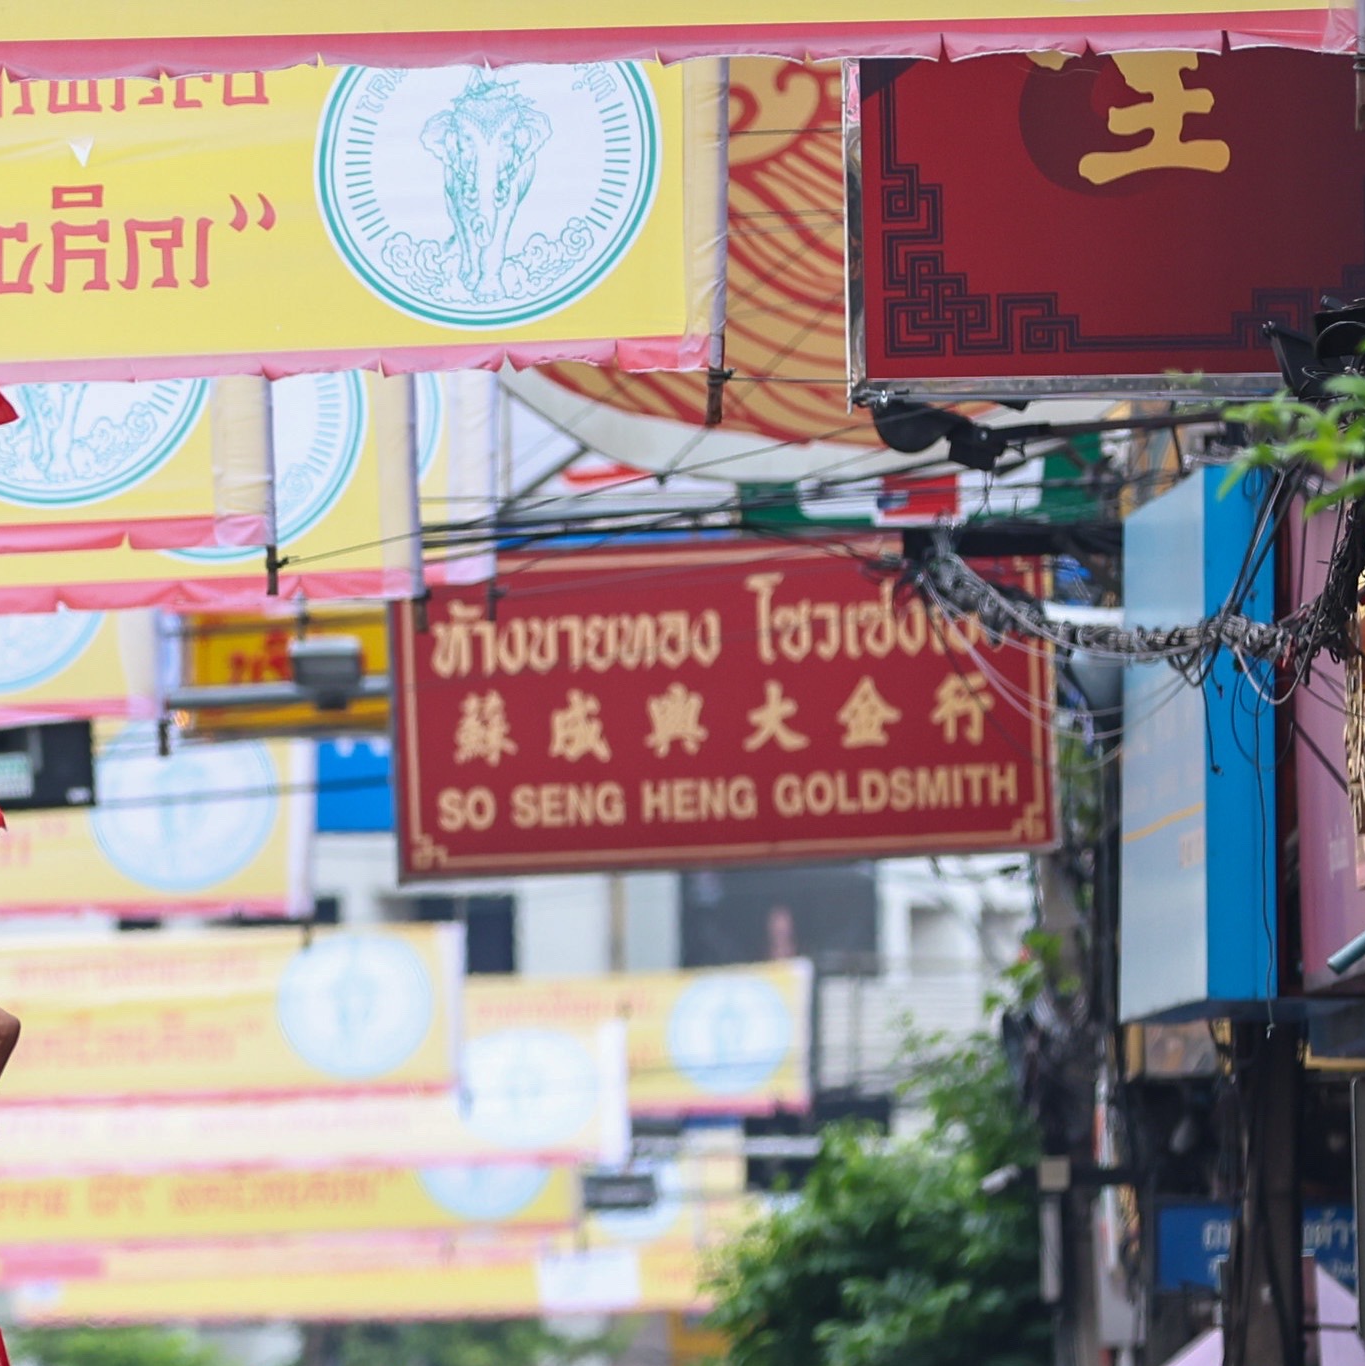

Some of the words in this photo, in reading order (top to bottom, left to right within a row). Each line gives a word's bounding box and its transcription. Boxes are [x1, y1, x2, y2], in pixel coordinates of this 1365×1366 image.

[438, 787, 496, 832] SO
[511, 780, 625, 829] SENG
[641, 775, 759, 823] HENG
[773, 763, 1018, 817] GOLDSMITH
